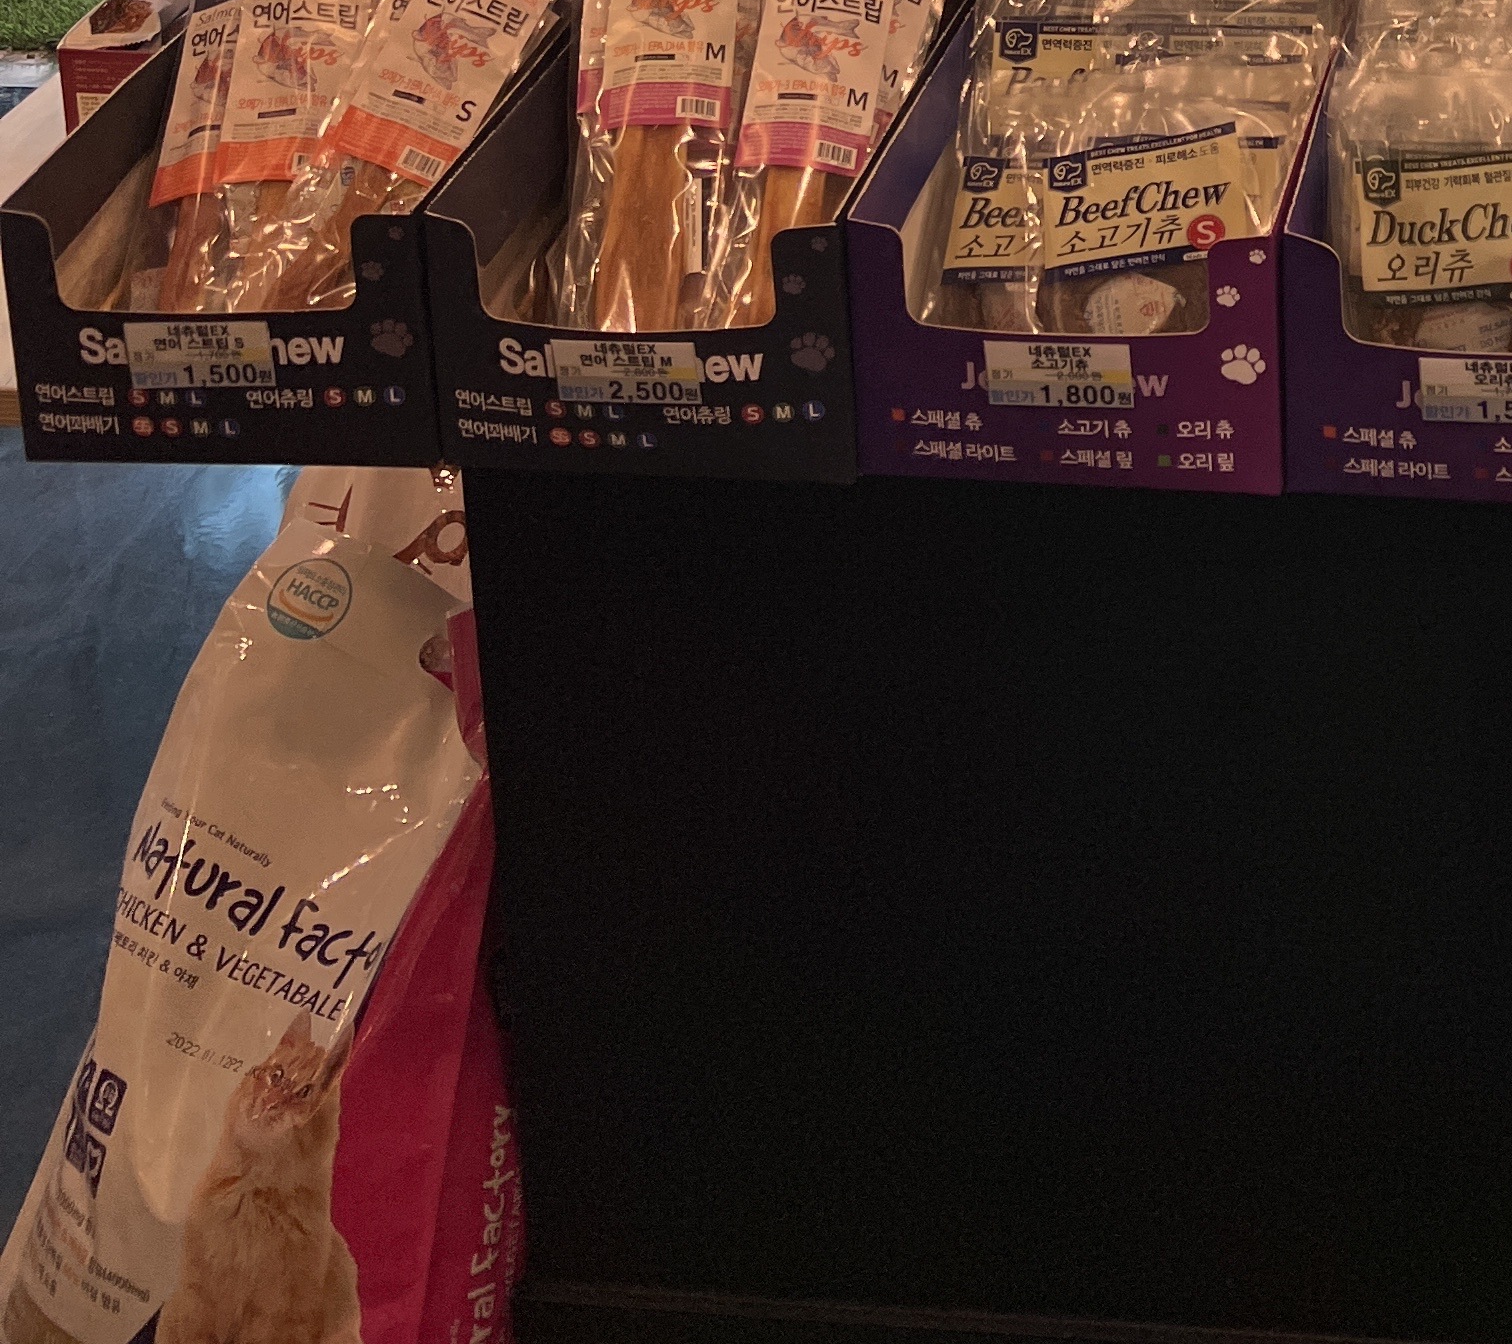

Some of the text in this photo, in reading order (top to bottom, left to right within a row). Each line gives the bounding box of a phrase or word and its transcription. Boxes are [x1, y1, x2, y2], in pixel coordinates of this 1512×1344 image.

[252, 2, 360, 31] 연어스트립
[706, 41, 726, 64] M
[456, 100, 477, 123] S
[847, 88, 869, 112] M
[1057, 181, 1232, 229] BeefChew
[1056, 215, 1184, 258] 소고기츄
[1377, 249, 1475, 286] 오리츄
[154, 337, 182, 351] 연어
[580, 355, 608, 368] 연어
[1031, 357, 1089, 372] 소고기츄
[184, 363, 274, 387] 1,500원
[35, 383, 115, 407] 연어스트립
[608, 380, 700, 403] 2,500원
[1041, 385, 1132, 408] 1,800원
[911, 409, 984, 432] 스페셜 츄
[1058, 419, 1133, 440] 소고기 츄
[285, 577, 340, 610] HACCP
[226, 832, 273, 868] Naturally
[133, 820, 285, 937] Natural
[192, 934, 208, 961] &
